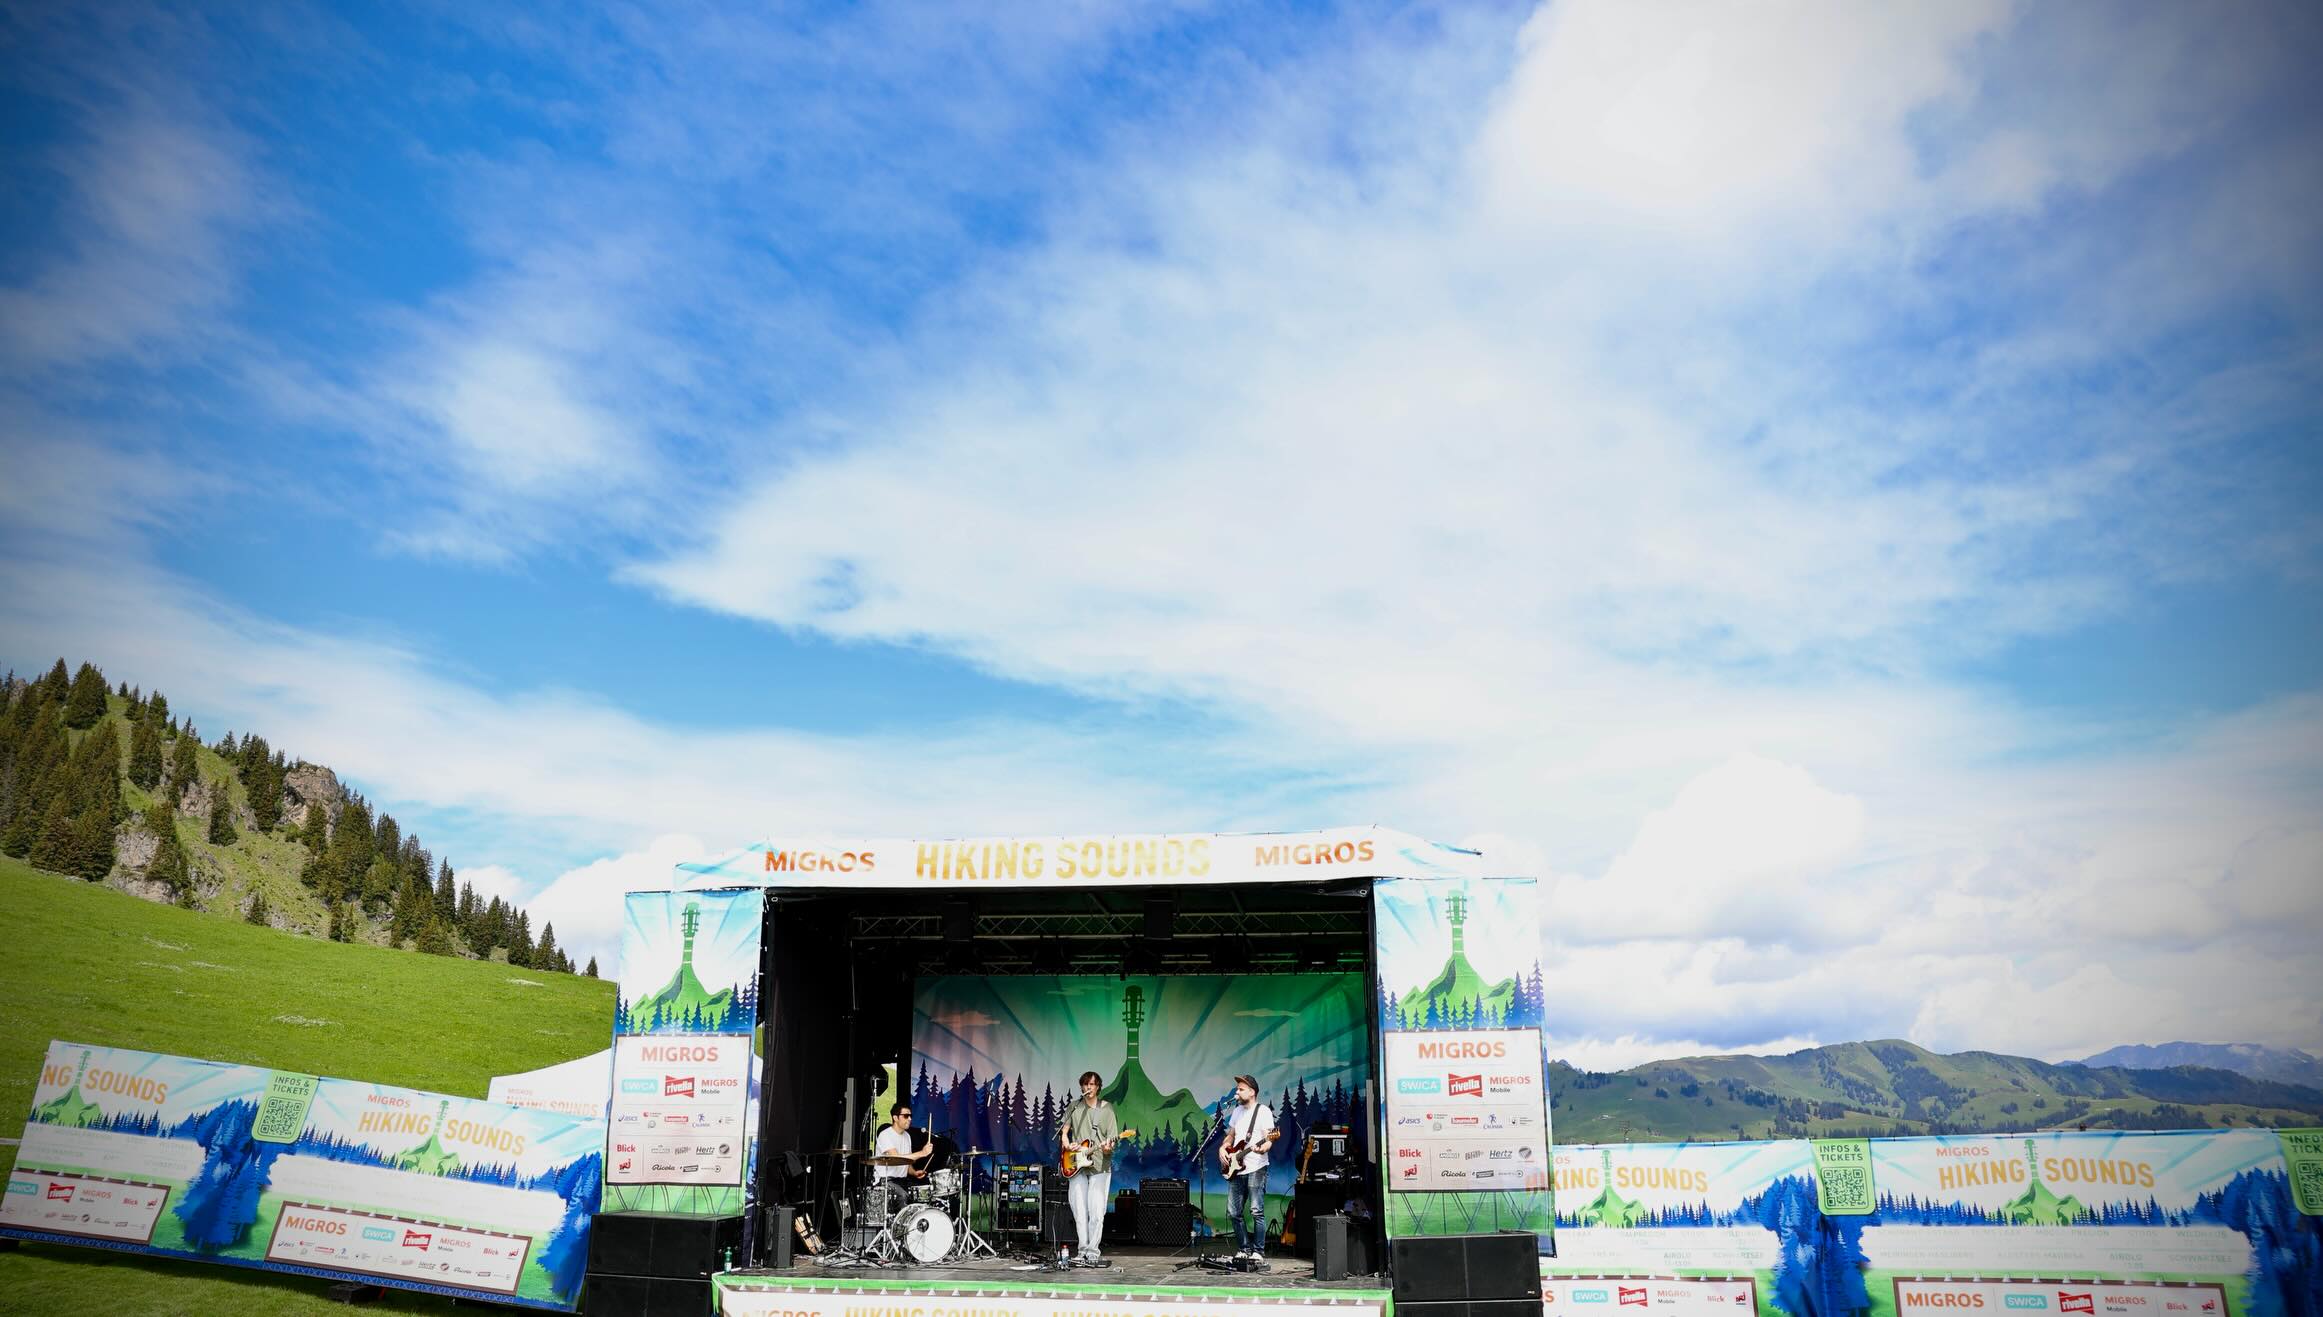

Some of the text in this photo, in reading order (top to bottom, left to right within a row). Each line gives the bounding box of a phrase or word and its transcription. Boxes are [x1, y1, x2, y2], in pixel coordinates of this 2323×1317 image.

[916, 839, 1211, 880] HIKING SOUNDS
[1254, 840, 1375, 867] MIGROS
[765, 852, 875, 872] MIGROS
[641, 1047, 719, 1062] MIGROS
[1418, 1042, 1506, 1059] MIGROS
[85, 1068, 167, 1105] SOUNDS
[275, 1076, 310, 1088] INFOS &
[701, 1079, 738, 1087] MIGROS
[1400, 1080, 1438, 1090] SWICA
[1450, 1078, 1480, 1093] rivella
[1489, 1076, 1531, 1085] MIGROS
[273, 1084, 309, 1096] TICKETS
[666, 1081, 693, 1094] rivella
[367, 1094, 410, 1108] MIGROS
[357, 1112, 525, 1156] HIKING SOUNDS
[2289, 1135, 2323, 1143] INFO
[616, 1144, 636, 1153] Blick
[1399, 1149, 1422, 1158] Blick
[1489, 1150, 1513, 1158] Hertz
[1820, 1144, 1860, 1153] INFOS &
[1936, 1147, 1990, 1157] MIGROS
[2291, 1145, 2323, 1153] TICK
[1441, 1170, 1467, 1178] Ricola
[1938, 1157, 2154, 1190] HIKING SOUNDS
[1616, 1167, 1708, 1193] SOUNDS
[285, 1215, 347, 1235] MIGROS
[440, 1238, 472, 1248] MIGROS
[1906, 1292, 1984, 1307] MIGROS
[2007, 1296, 2044, 1306] SWICA
[2105, 1296, 2147, 1305] MIGROS
[2166, 1302, 2189, 1310] Blick
